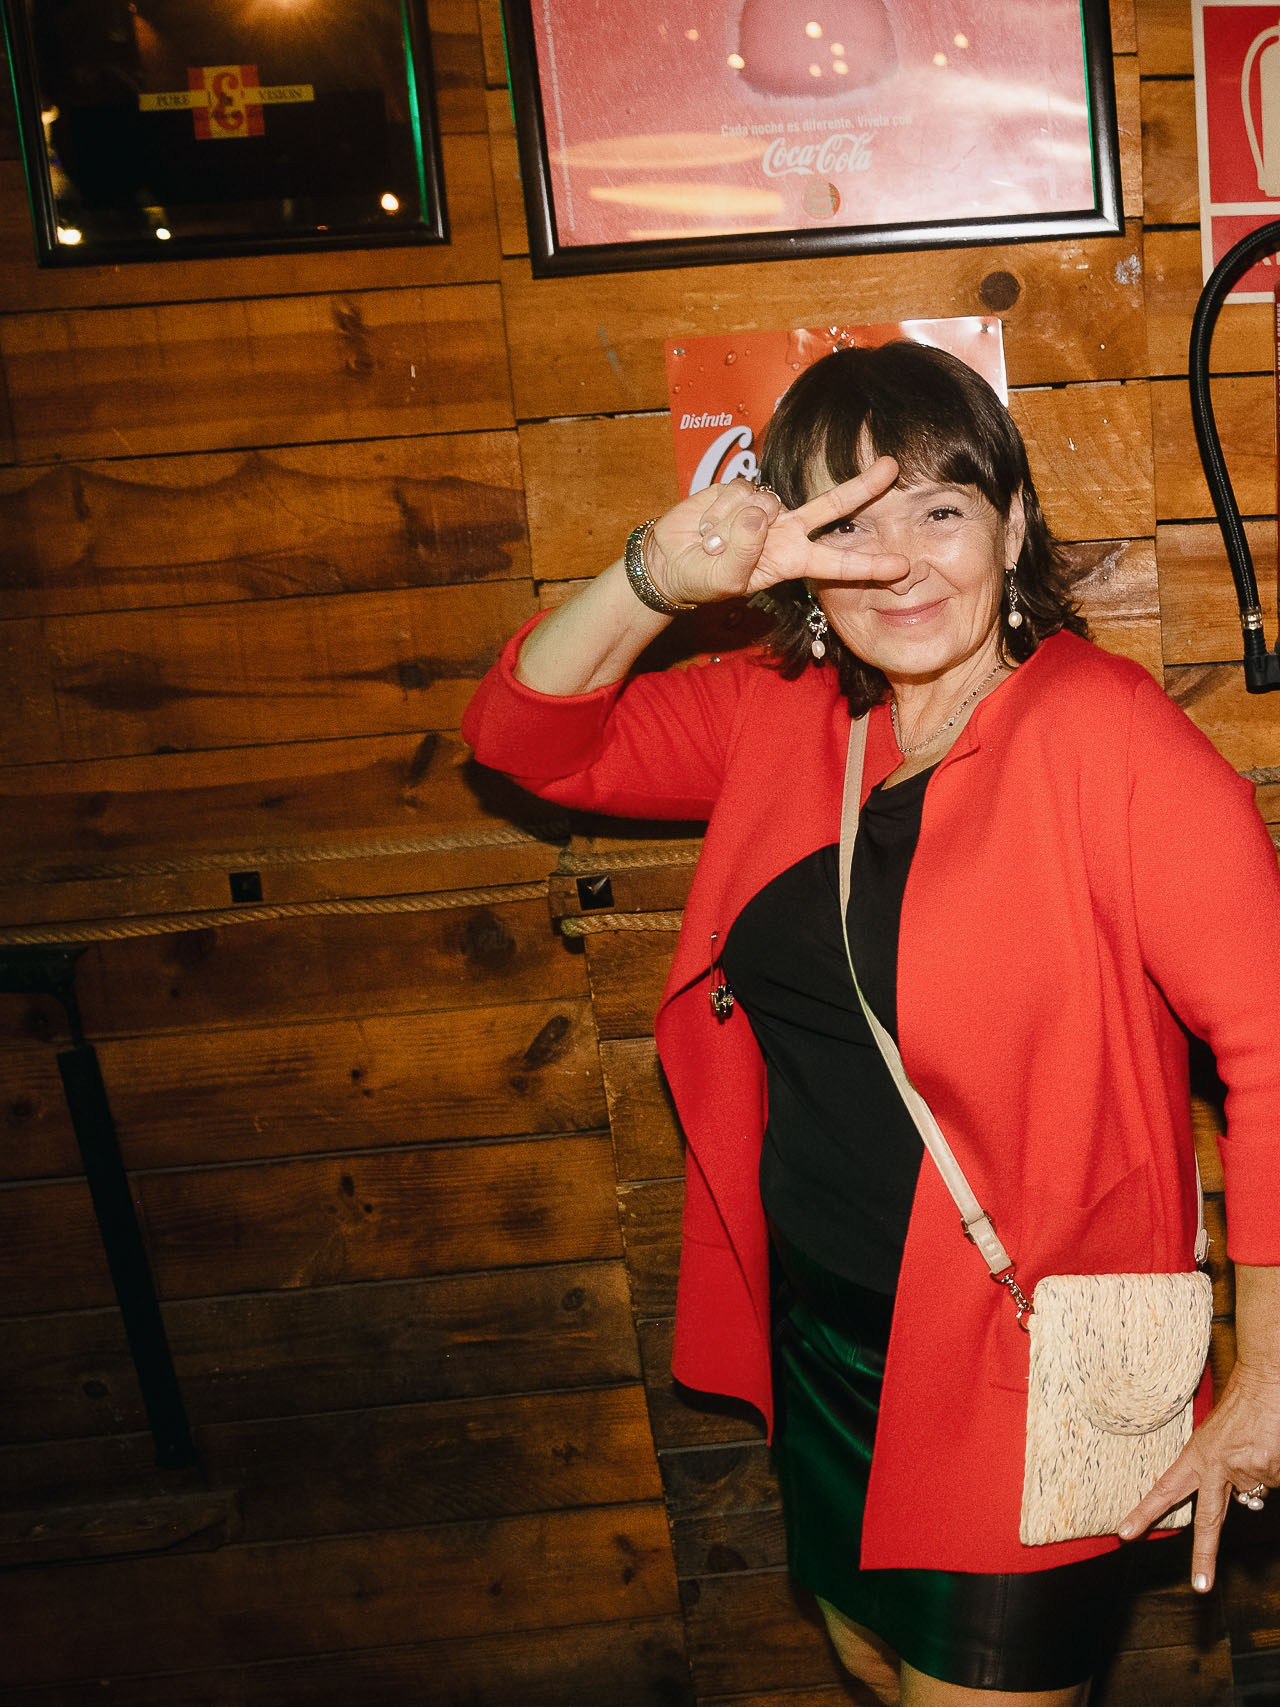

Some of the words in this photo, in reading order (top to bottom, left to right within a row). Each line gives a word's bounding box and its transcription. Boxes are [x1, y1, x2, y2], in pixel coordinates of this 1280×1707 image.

[752, 122, 784, 136] noche
[787, 122, 800, 133] es
[762, 131, 878, 178] Coca-Cola
[680, 412, 733, 430] Disfruta
